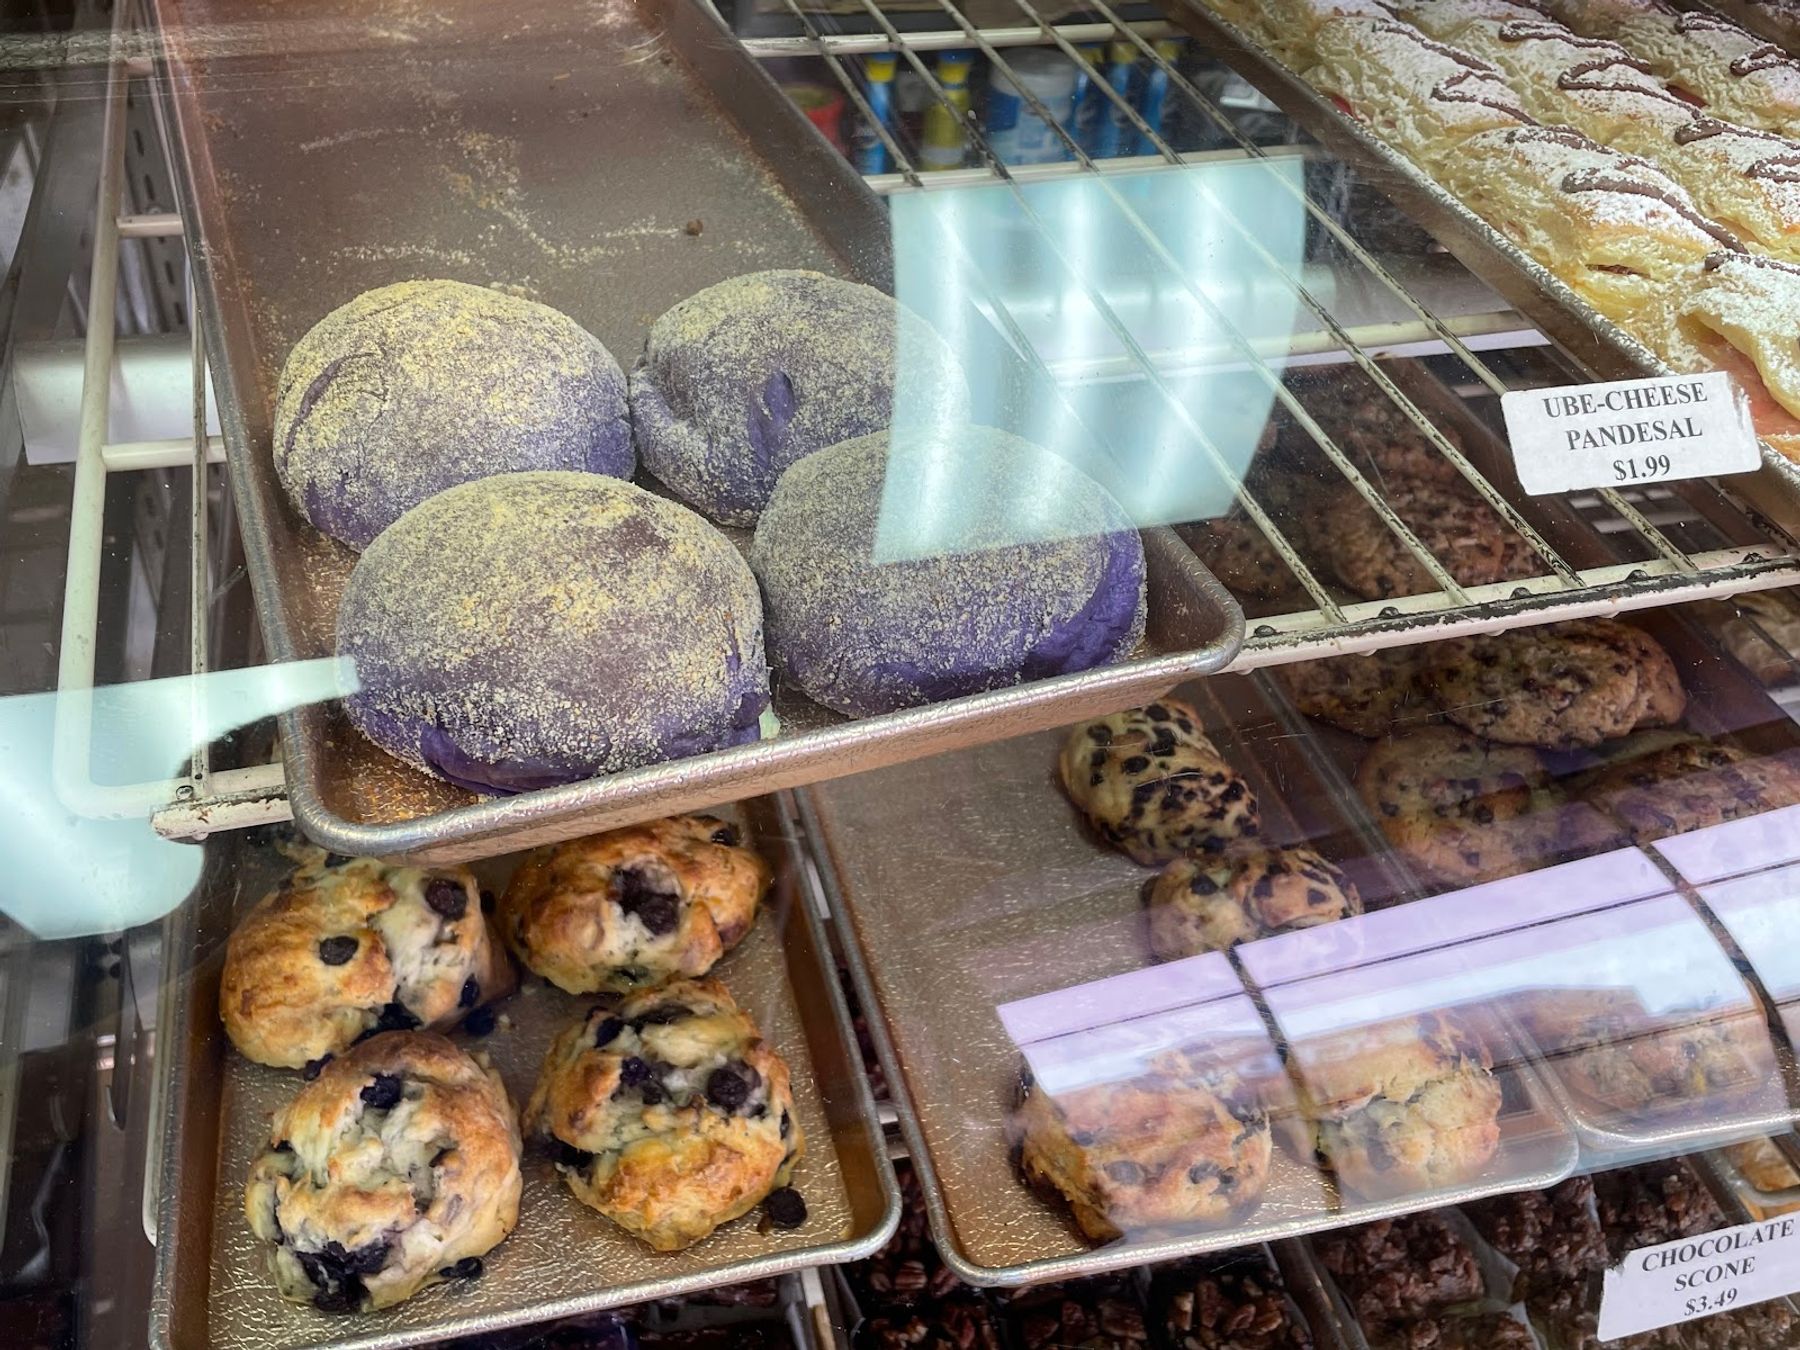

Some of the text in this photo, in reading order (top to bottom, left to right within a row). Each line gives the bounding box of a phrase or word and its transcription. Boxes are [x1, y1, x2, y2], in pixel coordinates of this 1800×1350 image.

[1542, 382, 1708, 418] UBE-CHEESE
[1565, 417, 1703, 450] PANDESAL
[1613, 454, 1671, 481] $1.99
[1642, 1219, 1795, 1272] CHOCOLATE
[1674, 1256, 1756, 1292] SCONE
[1684, 1288, 1738, 1316] $3.49
